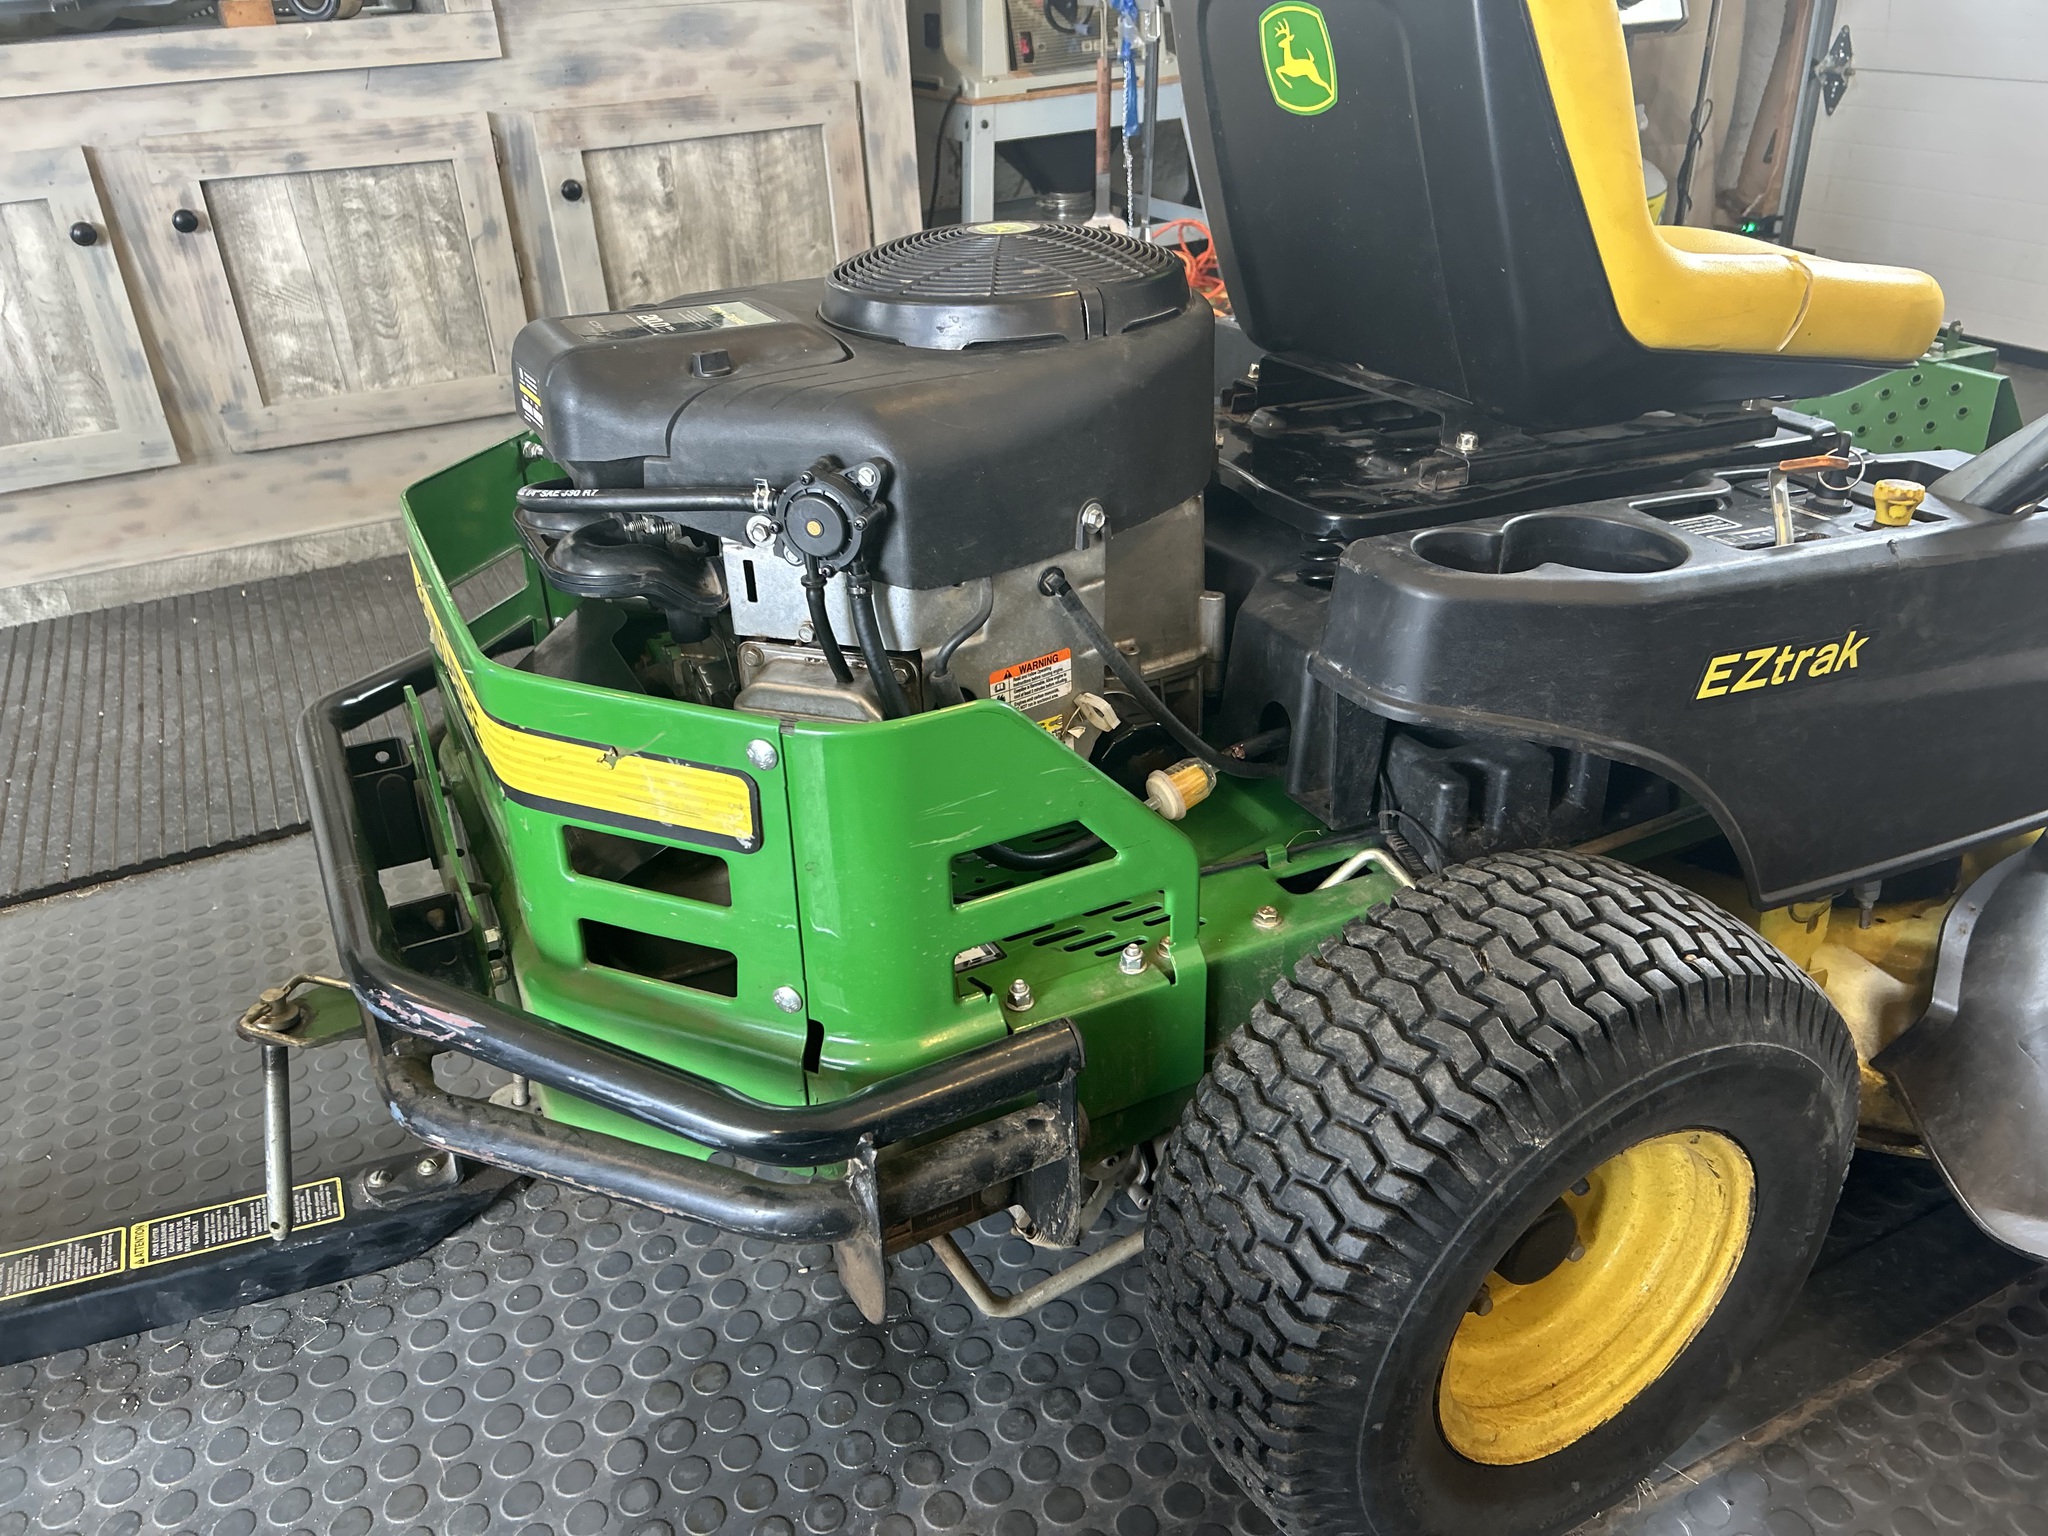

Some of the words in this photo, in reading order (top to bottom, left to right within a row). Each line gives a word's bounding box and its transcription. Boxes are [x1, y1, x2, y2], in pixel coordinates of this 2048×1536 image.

[540, 489, 561, 497] SAE
[582, 489, 599, 497] R7
[1019, 654, 1059, 674] WARNING
[1696, 631, 1870, 700] EZtrak
[135, 1225, 145, 1257] ATTENTION
[191, 1221, 199, 1244] CONTRÔLE
